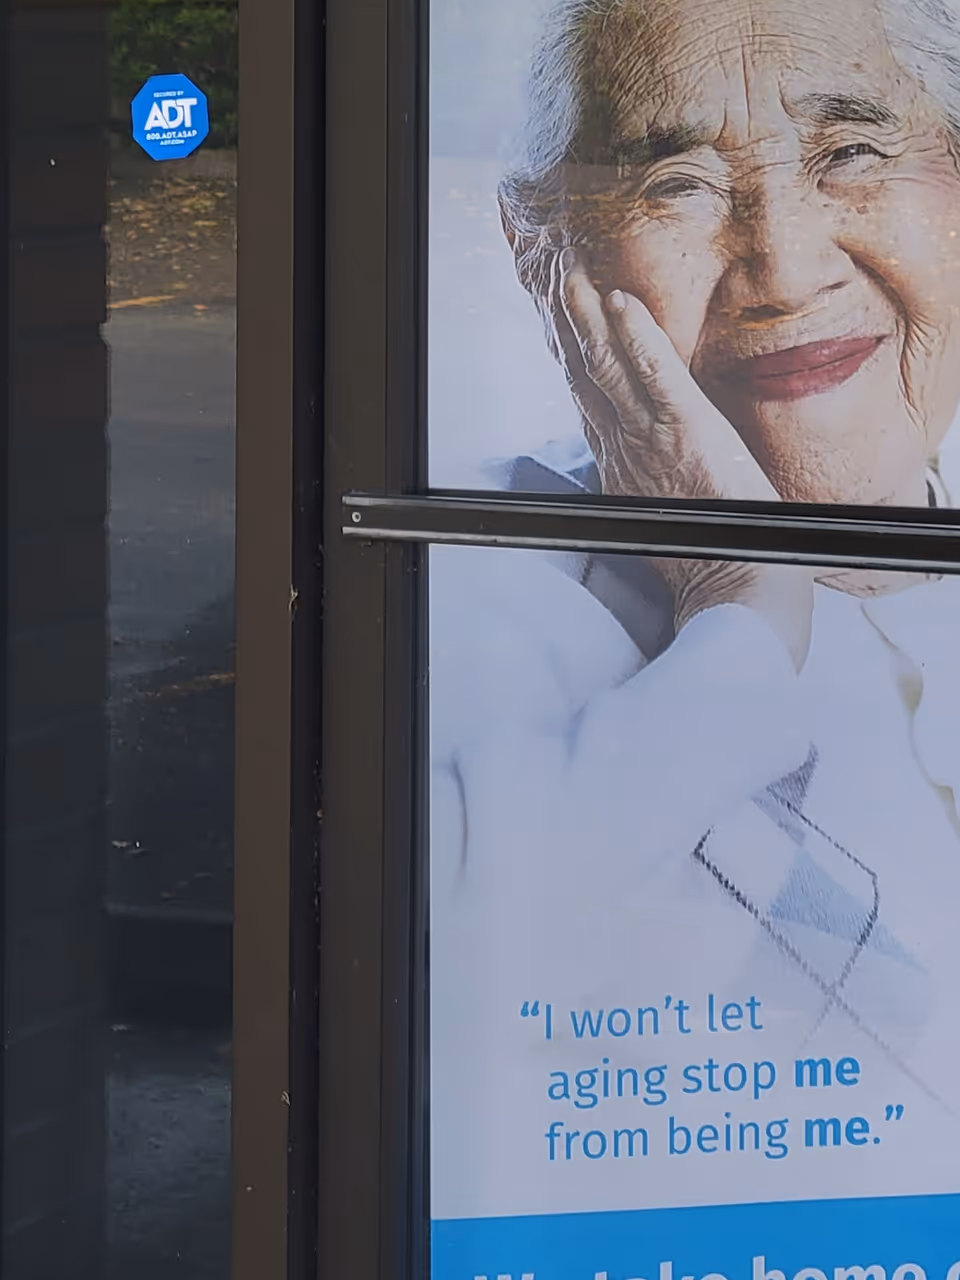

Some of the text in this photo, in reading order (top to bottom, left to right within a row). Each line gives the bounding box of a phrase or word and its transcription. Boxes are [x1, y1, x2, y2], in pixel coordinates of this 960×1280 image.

[144, 97, 197, 130] ADT
[520, 993, 763, 1040] “I won’t let
[547, 1056, 861, 1109] aging stop me
[544, 1104, 904, 1161] from being me.”
